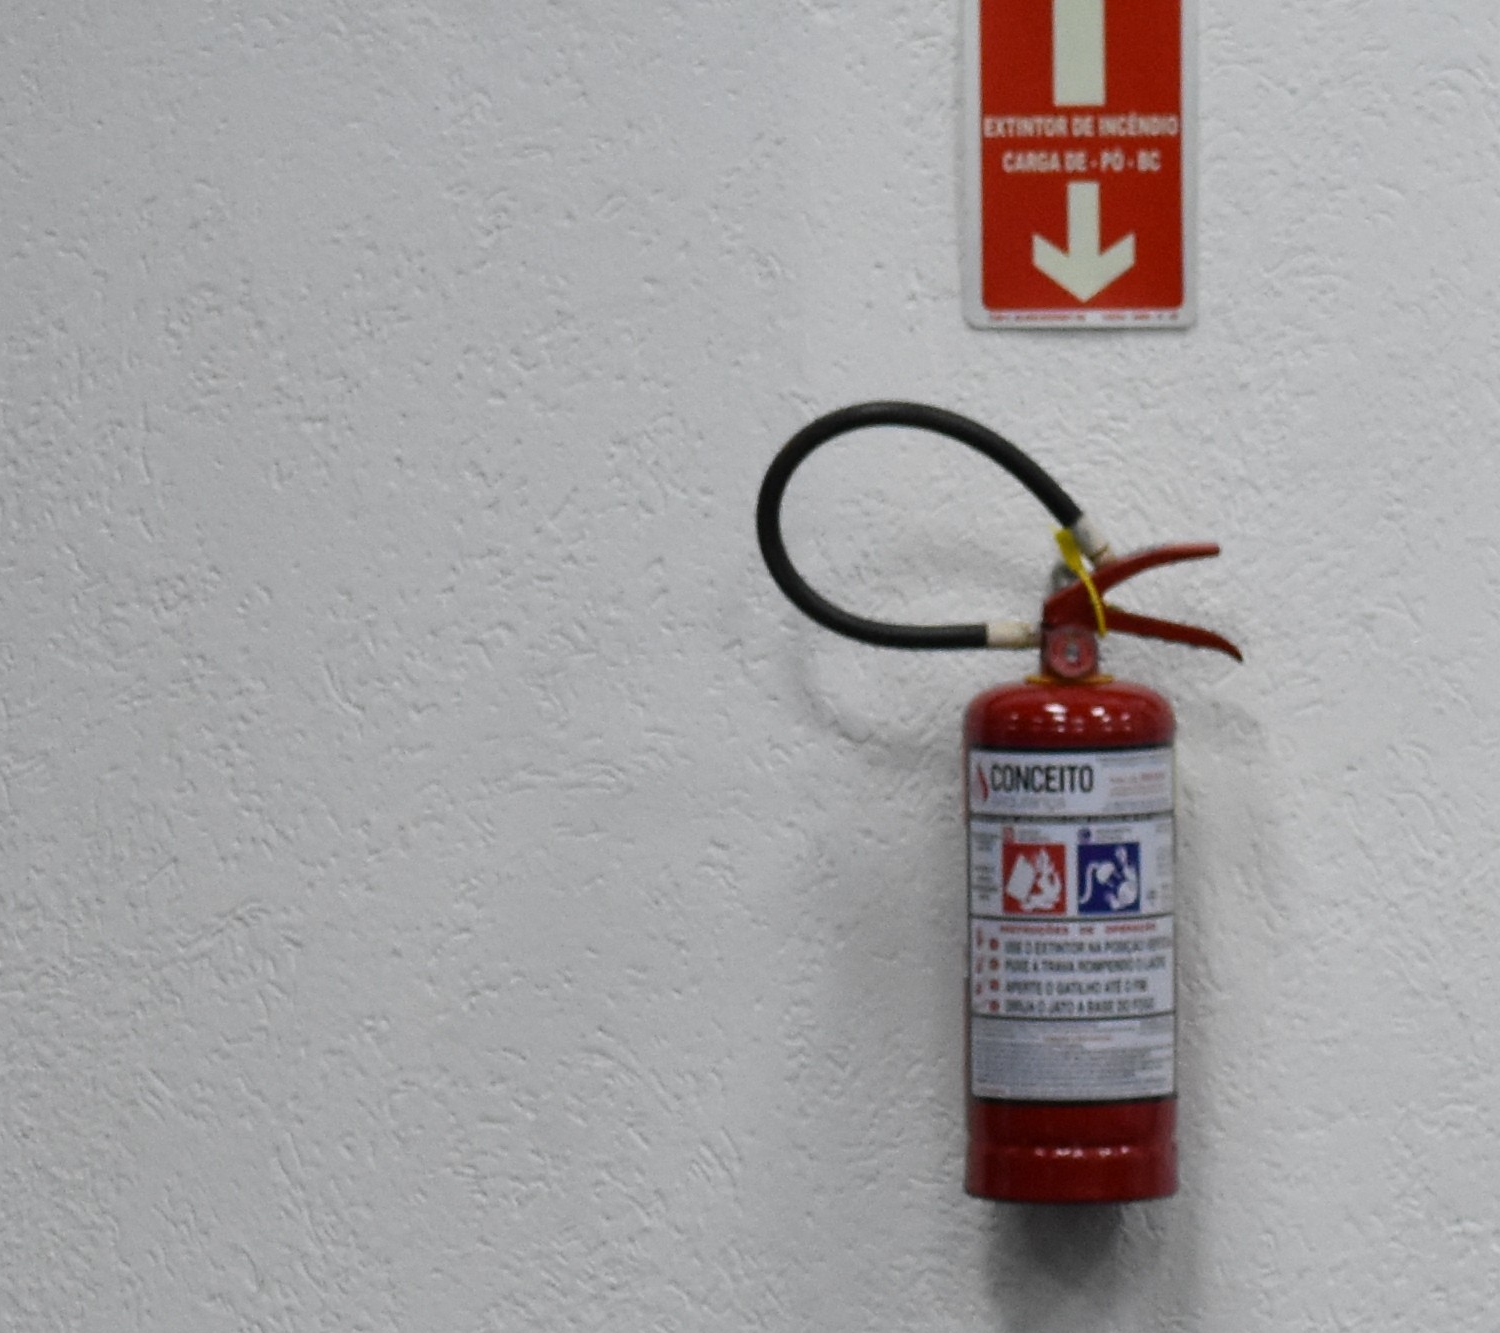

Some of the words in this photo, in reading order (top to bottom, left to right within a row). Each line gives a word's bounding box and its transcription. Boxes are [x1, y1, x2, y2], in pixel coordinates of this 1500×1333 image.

[983, 116, 1068, 137] EXTINTOR
[1072, 116, 1094, 137] DE
[1098, 112, 1178, 137] INCÊNDIO
[1002, 150, 1061, 173] CARGA
[990, 764, 1094, 793] CONCEITO
